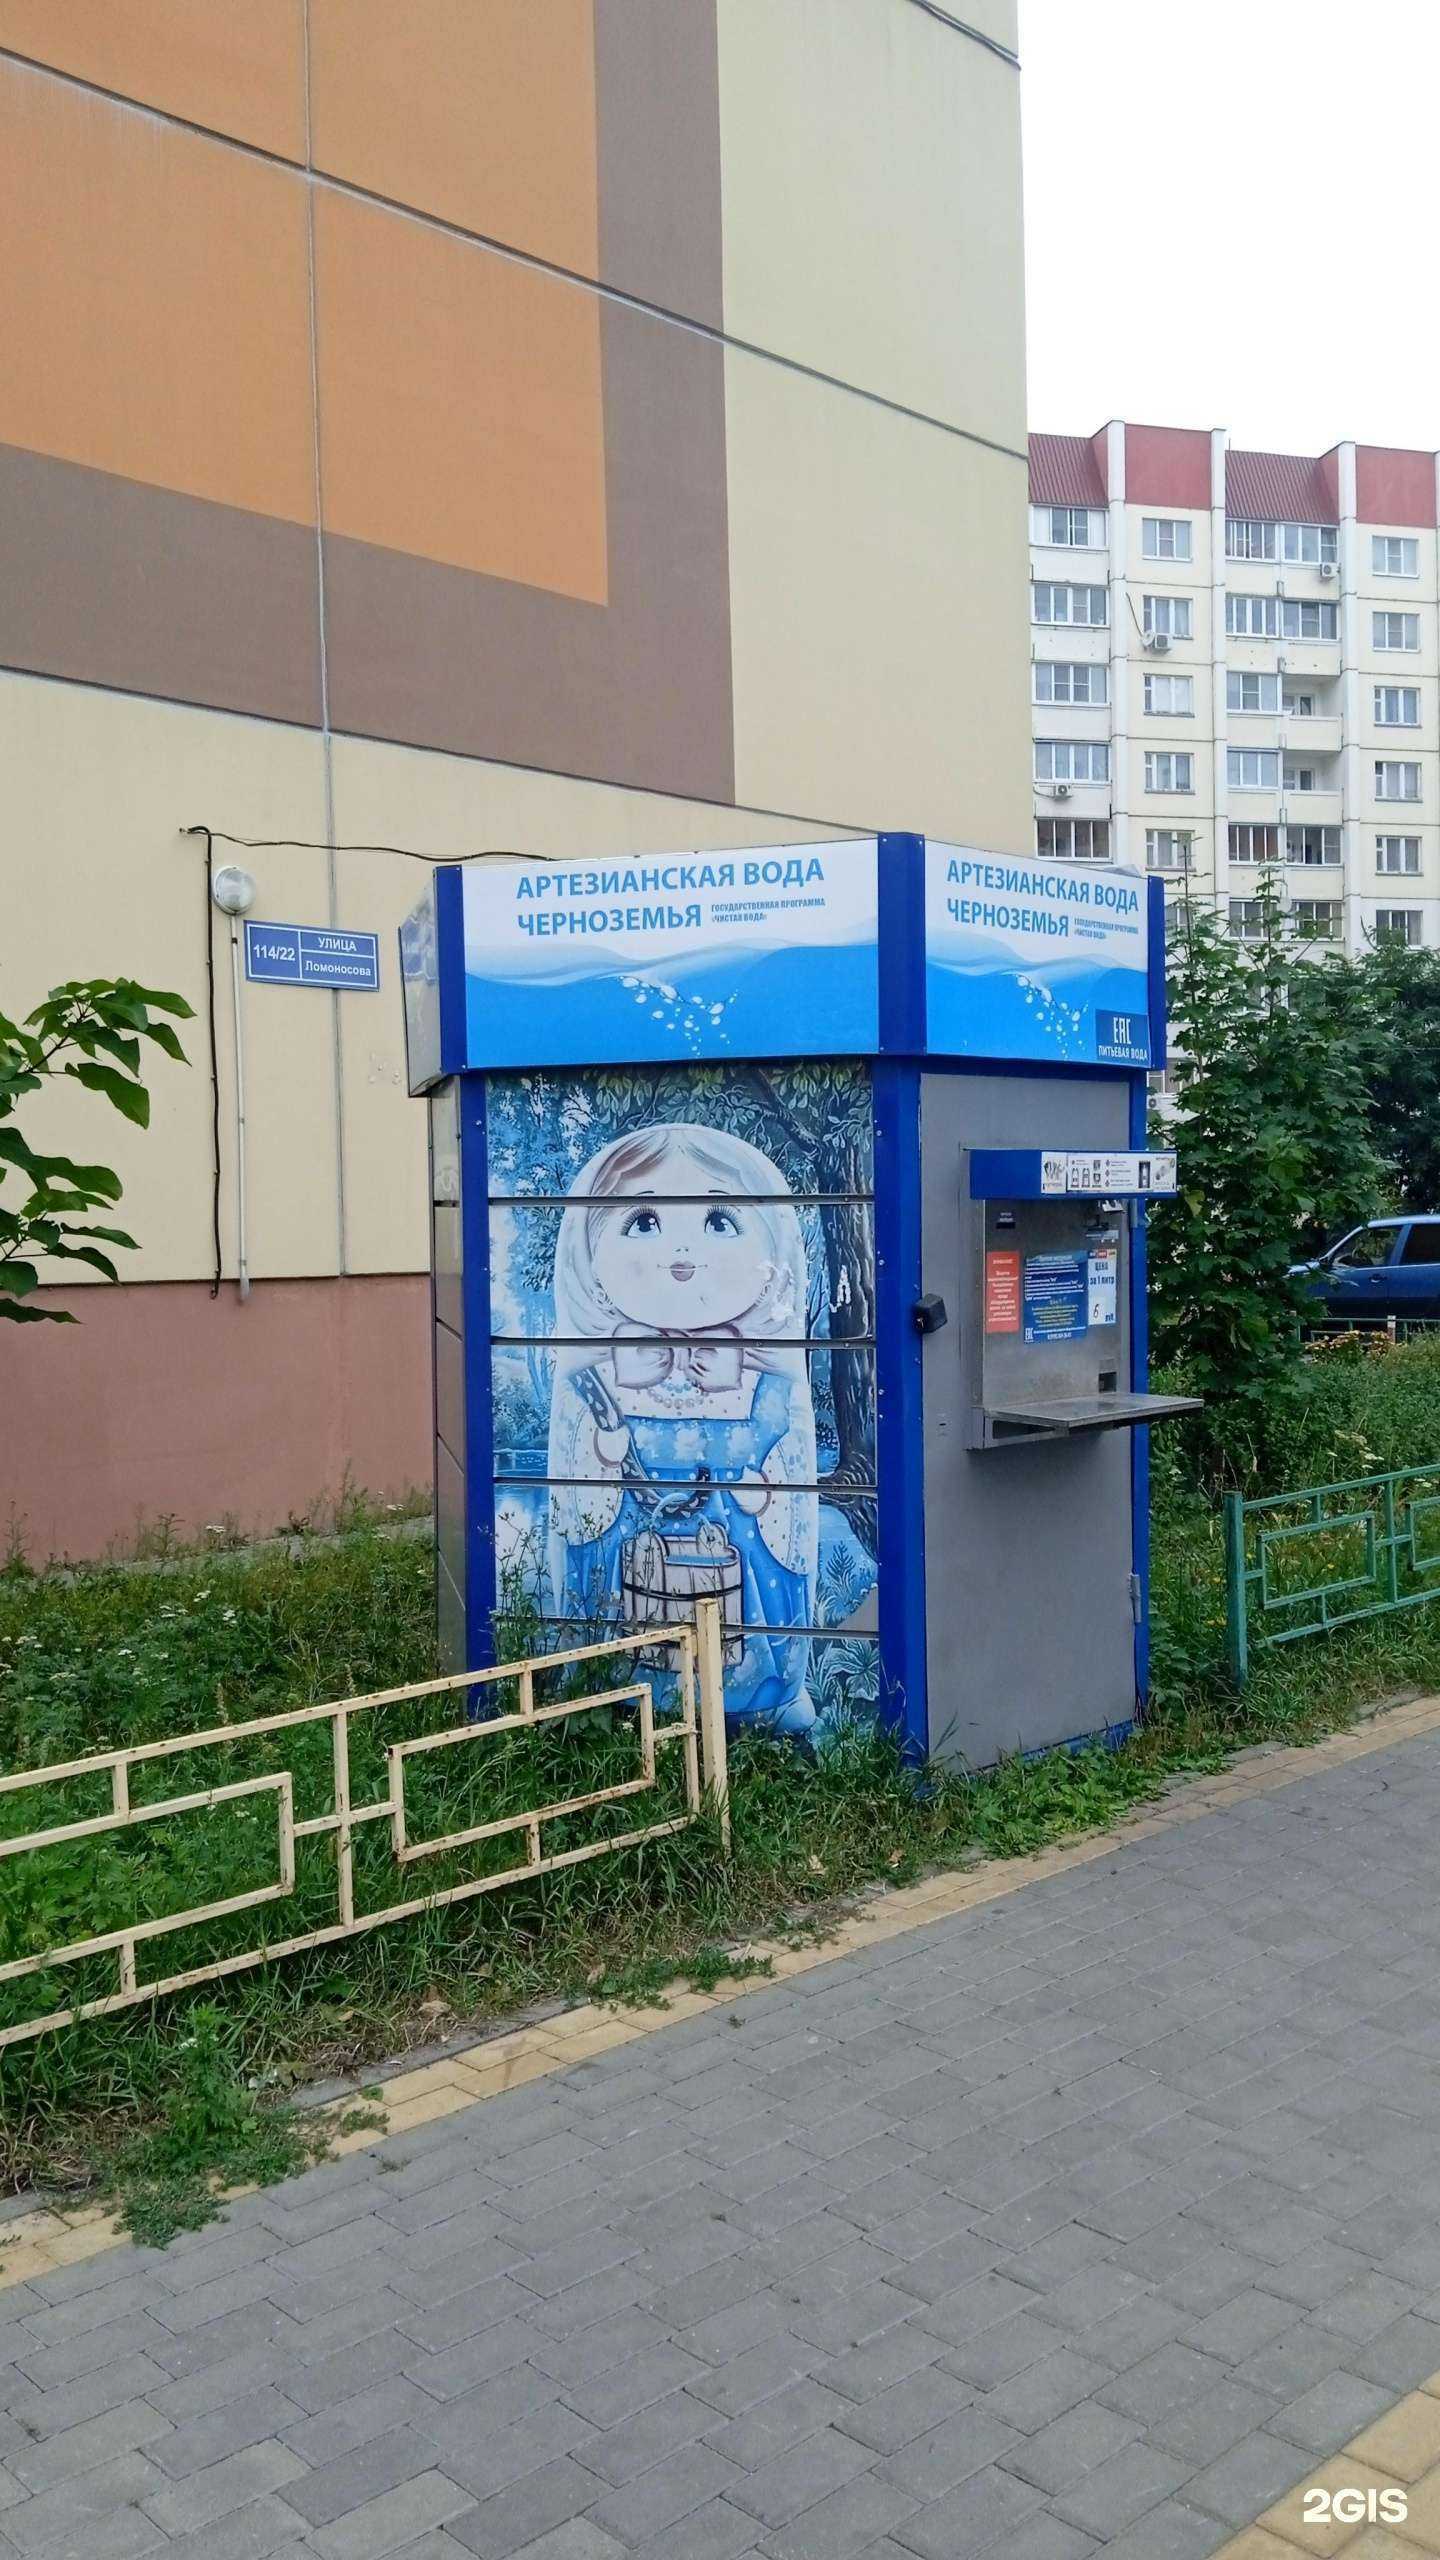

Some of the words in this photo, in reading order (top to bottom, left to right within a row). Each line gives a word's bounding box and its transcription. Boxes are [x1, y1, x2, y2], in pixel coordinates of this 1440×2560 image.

[516, 863, 735, 899] АРТЕЗИАНСКАЯ
[744, 858, 825, 889] ВОДА
[947, 859, 1090, 904] АРТЕЗИАНСКАЯ
[1094, 885, 1139, 915] ВОДА
[711, 900, 780, 912] ГОСУДАРСТВЕННАЯ
[517, 904, 701, 936] ЧЕРНОЗЕМЬЯ
[947, 898, 1069, 937] ЧЕРНОЗЕМЬЯ
[253, 944, 296, 962] 114/22
[318, 937, 357, 952] УЛИЦА
[305, 960, 371, 976] Ломоносова
[1098, 1045, 1130, 1058] ПИТЬЕВАЯ
[1131, 1048, 1148, 1061] ВОДА
